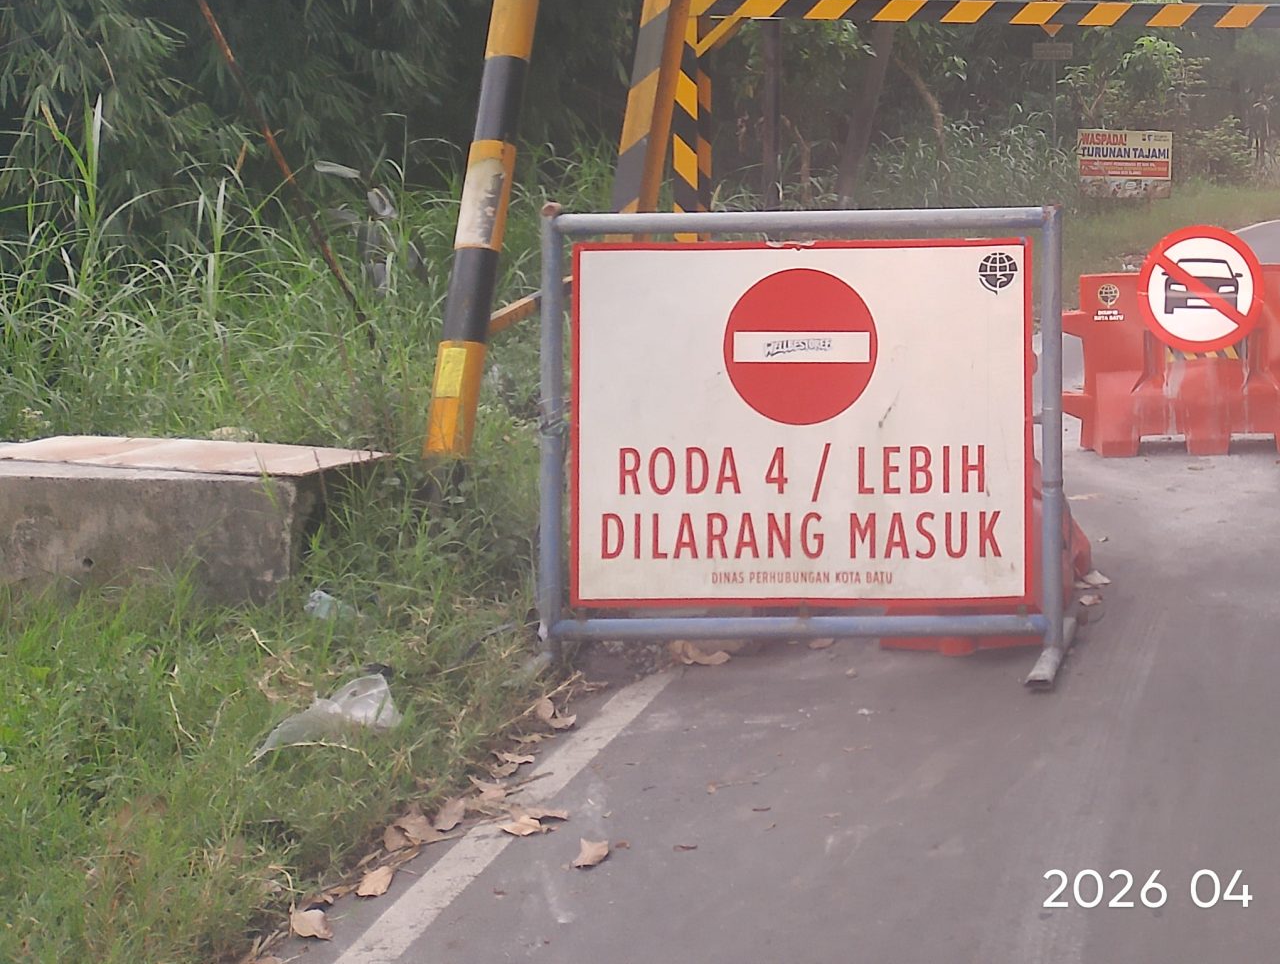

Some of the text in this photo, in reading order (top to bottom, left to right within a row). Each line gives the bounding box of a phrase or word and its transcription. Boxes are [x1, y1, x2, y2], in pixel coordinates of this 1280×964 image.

[1080, 133, 1127, 146] WASPADA!
[1081, 147, 1131, 159] TURUNAN
[619, 443, 985, 502] RODA 4 / LEBIH
[601, 511, 1002, 559] DILARANG MASUK
[711, 571, 893, 584] DINAS PERHUBUNGAN KOTA BATU
